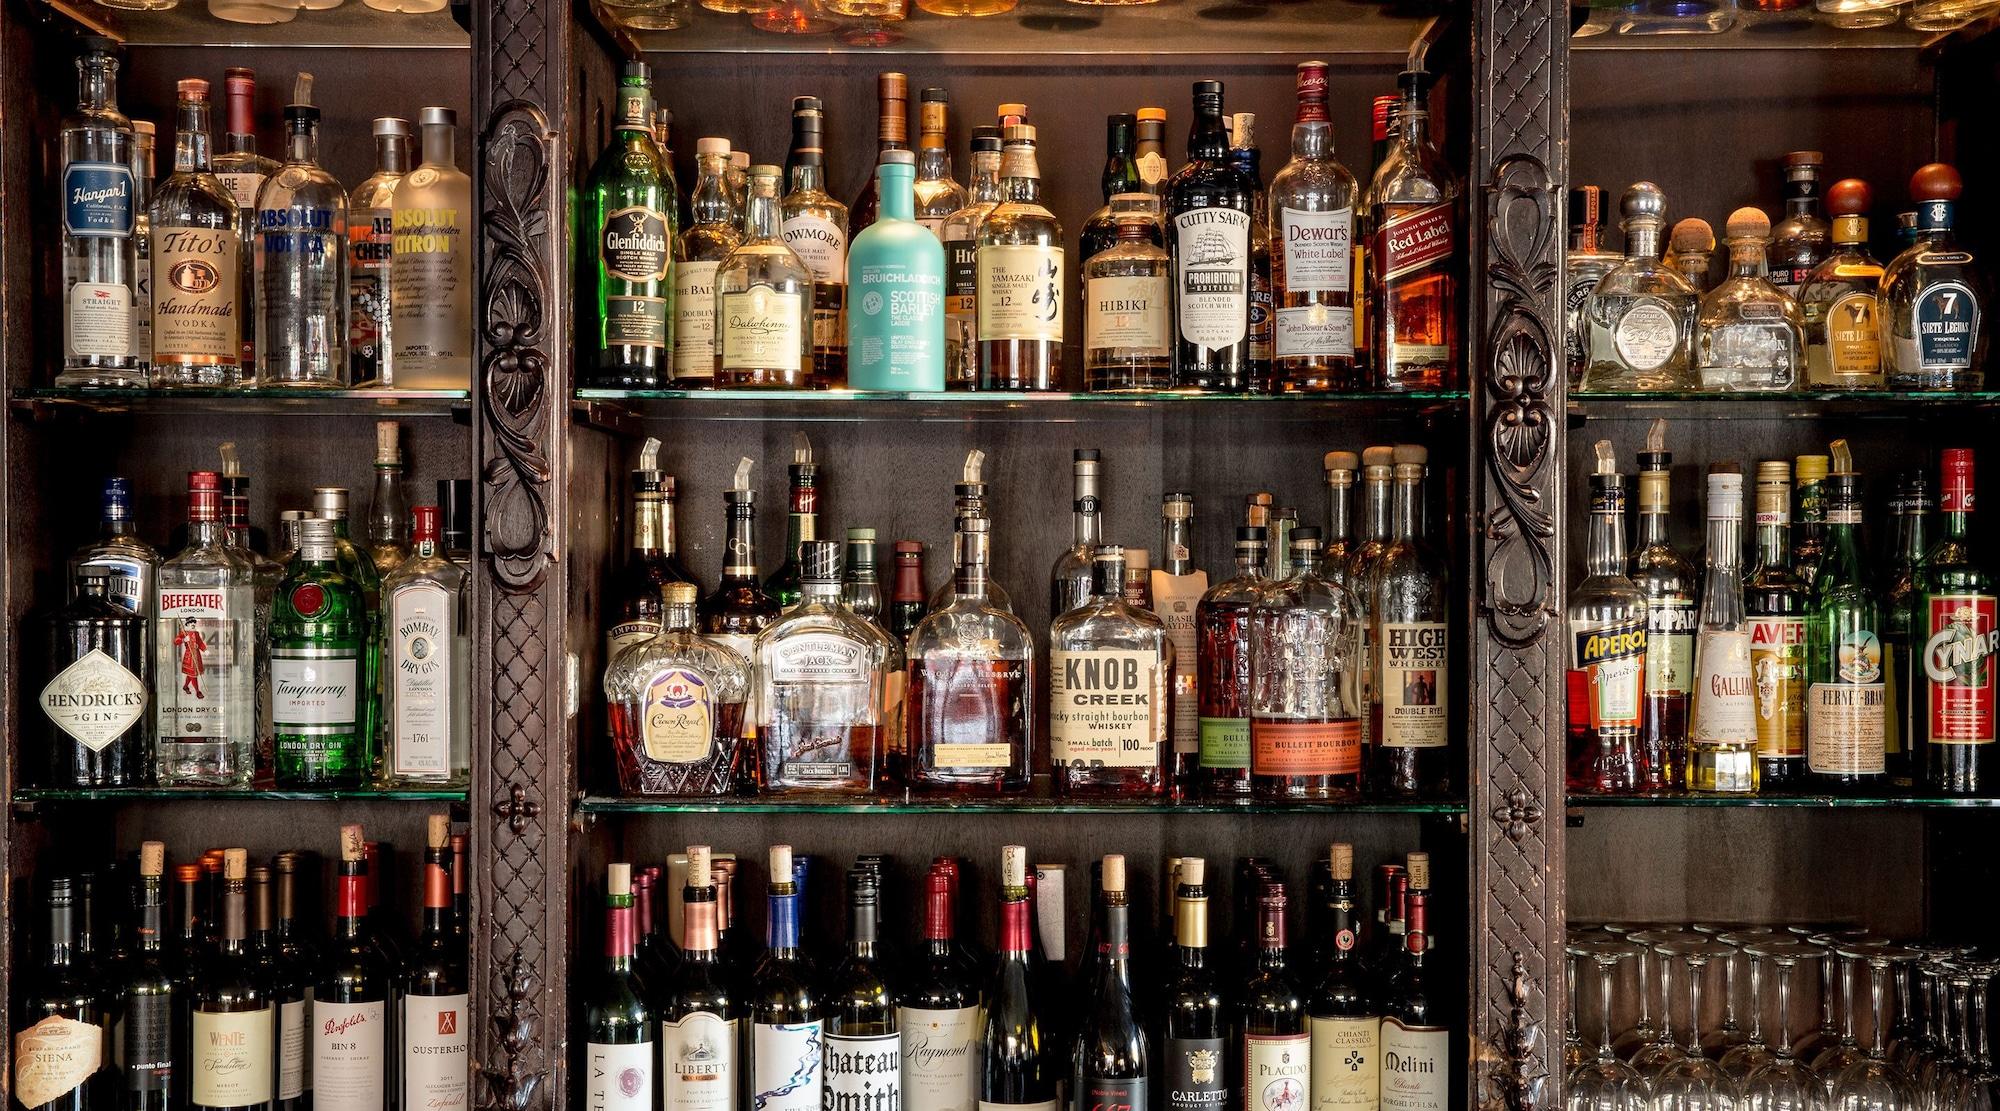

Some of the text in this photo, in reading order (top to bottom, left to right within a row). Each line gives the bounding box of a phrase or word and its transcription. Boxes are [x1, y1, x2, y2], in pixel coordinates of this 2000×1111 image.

[73, 186, 119, 205] Hangar
[87, 216, 115, 224] Vodka
[260, 208, 331, 228] ABSOLUT
[1180, 211, 1247, 229] CUTTY SARK
[371, 217, 392, 235] AB
[784, 228, 841, 250] OWMORE
[1290, 225, 1348, 242] Dewar's
[1388, 220, 1450, 253] Red Label
[265, 235, 325, 253] VODKA
[395, 235, 449, 254] CITRON
[607, 232, 666, 252] Glenfiddich
[356, 243, 392, 260] CHER
[862, 273, 941, 284] BRUICHLADDICH
[992, 274, 1034, 282] YAMAZAKI
[1189, 272, 1240, 285] PROHIBITION
[1794, 269, 1811, 282] ES
[691, 285, 715, 295] BALV
[890, 290, 940, 304] SCOTTISH
[1000, 296, 1011, 307] 12
[1943, 293, 1957, 314] 7
[158, 297, 232, 317] Handmade
[633, 301, 645, 312] 12
[891, 303, 935, 316] BARLEY
[960, 298, 973, 310] 12
[1100, 300, 1147, 312] HIBIKI
[1855, 303, 1868, 324] 7
[174, 319, 217, 328] VODKA
[1922, 321, 1969, 334] SIETE LEGUAS
[1084, 501, 1094, 512] 10
[109, 577, 138, 596] OUTH
[162, 593, 224, 611] BEEFEATER
[1168, 615, 1194, 623] BASIL
[1648, 608, 1697, 631] MPARI
[400, 622, 441, 639] BOMBAY
[614, 625, 659, 636] IMPORTE
[1752, 623, 1806, 644] AVER
[1389, 628, 1445, 647] HIGH
[781, 642, 857, 658] GENTLEMAN
[1584, 629, 1647, 660] APEROL
[804, 655, 832, 665] JACK
[1389, 648, 1445, 659] WEST
[1924, 629, 2000, 682] CYNAR
[400, 659, 440, 675] DRY GIN
[1066, 657, 1138, 690] KNOB
[978, 669, 1022, 679] RESERVE
[277, 680, 346, 700] Tanqueray
[48, 692, 142, 707] HENDRICK'S
[1073, 694, 1148, 705] CREEK
[1823, 690, 1885, 706] FERNET-BRAN
[82, 713, 112, 722] GIN
[1072, 711, 1149, 724] straight bourbon
[1395, 707, 1425, 715] DOUBLE
[652, 713, 702, 729] Crown Royal
[413, 734, 429, 743] 1761
[1092, 737, 1113, 747] batch
[1122, 739, 1140, 751] 100
[1275, 740, 1357, 749] BULLEIT BOURBON
[280, 742, 308, 750] LONDON
[210, 1032, 245, 1046] WENTE
[1338, 1030, 1370, 1038] CHIANTI
[331, 1042, 357, 1051] BIN 8
[413, 1045, 468, 1055] OUSTERHO
[903, 1036, 970, 1067] Raymond
[35, 1053, 73, 1063] SIENA
[824, 1043, 897, 1079] Chateau
[1385, 1051, 1434, 1073] Melini
[136, 1061, 171, 1071] punto final
[594, 1054, 605, 1078] LA
[674, 1063, 728, 1074] LIBERTY
[1260, 1064, 1307, 1076] PLACIDO
[1172, 1090, 1228, 1102] CARLETTO
